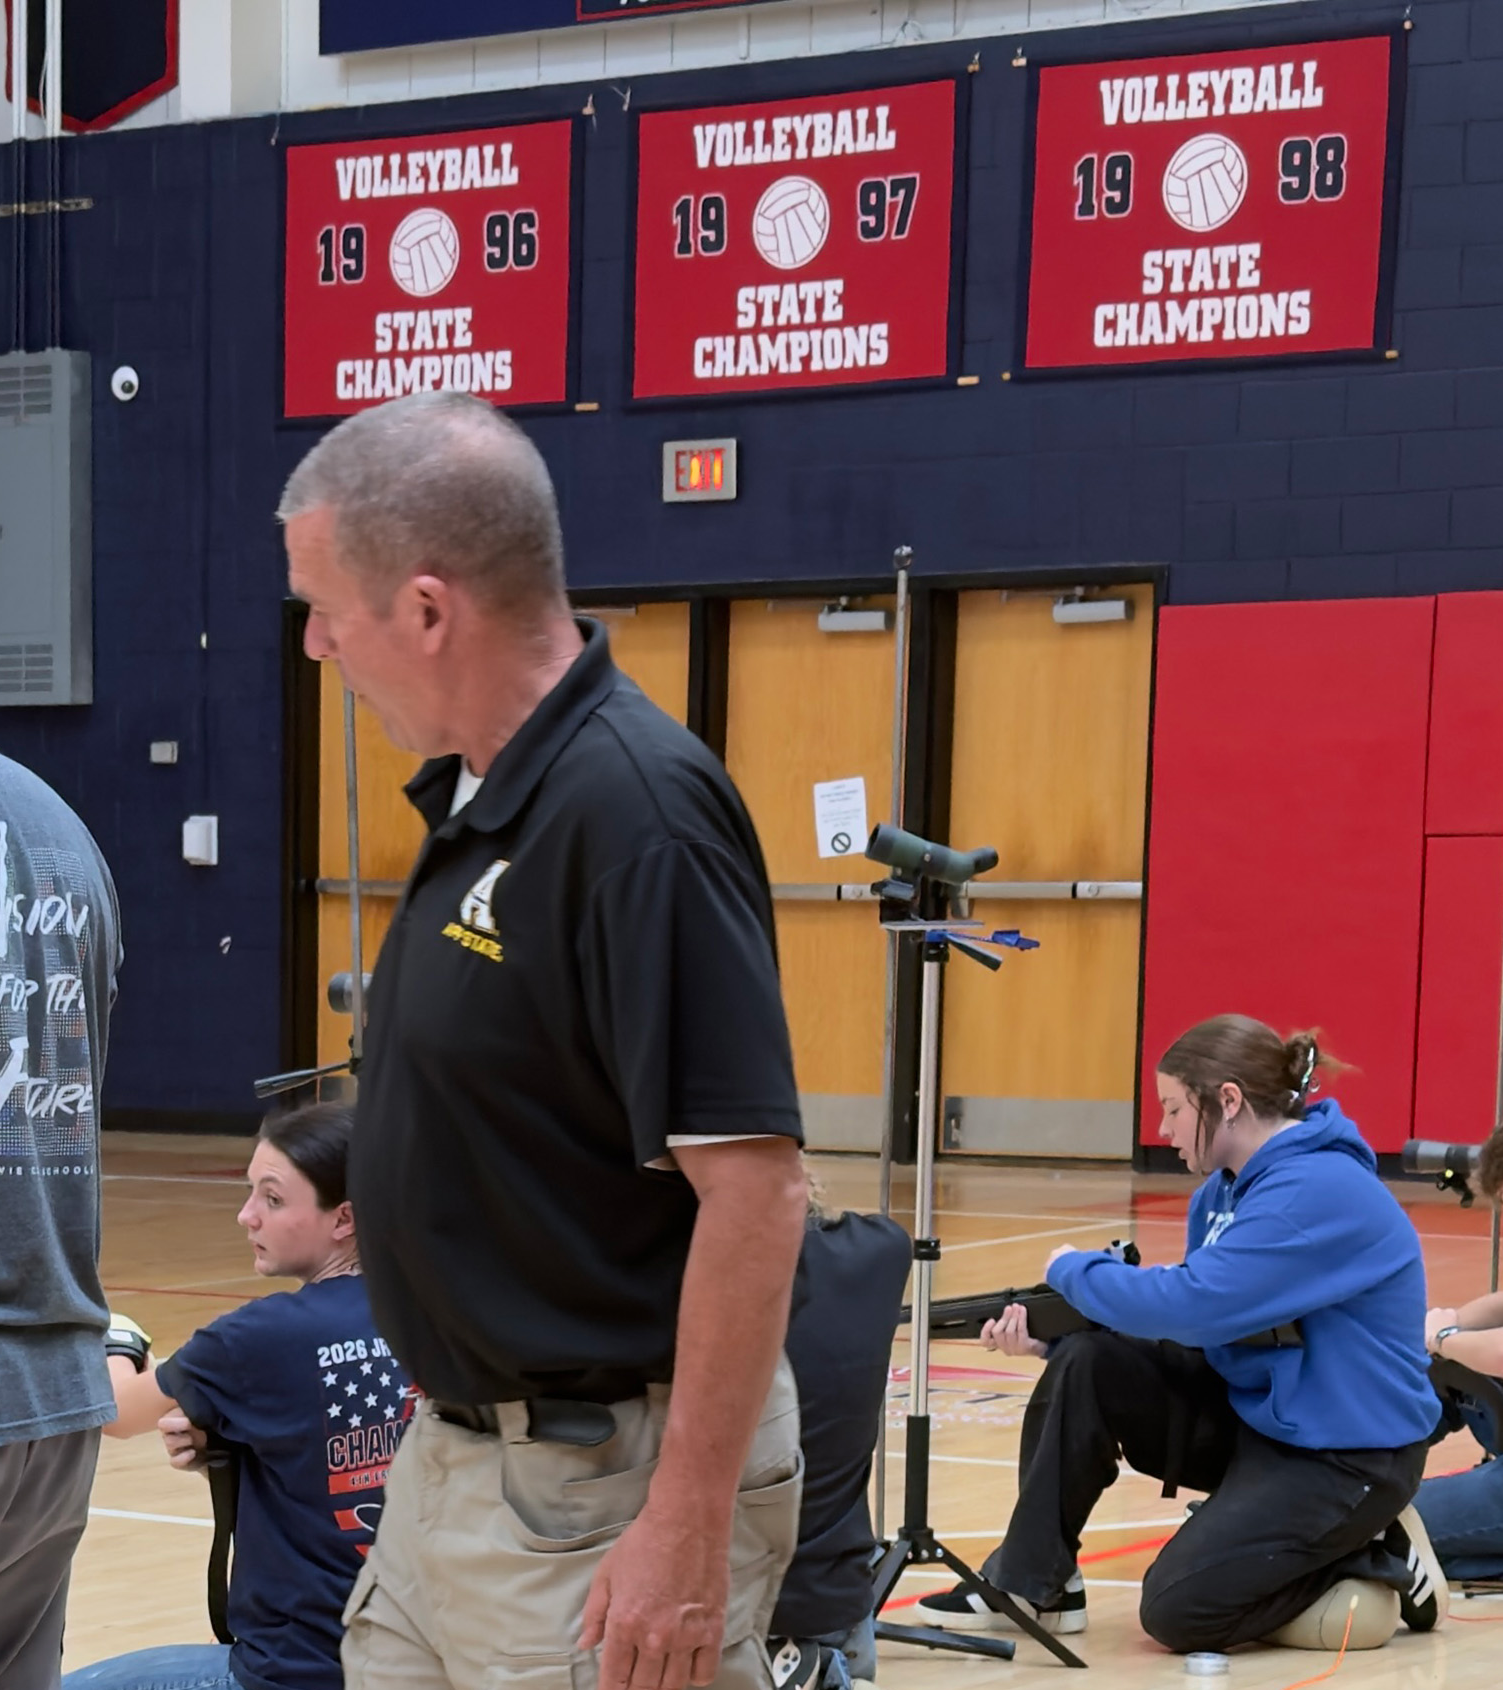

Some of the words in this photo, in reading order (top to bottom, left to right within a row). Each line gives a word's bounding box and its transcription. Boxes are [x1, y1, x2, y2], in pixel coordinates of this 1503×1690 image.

[1100, 60, 1324, 125] VOLLEYBALL
[693, 105, 896, 168] VOLLEYBALL
[335, 143, 519, 200] VOLLEYBALL
[1074, 151, 1134, 220] 19
[1278, 133, 1347, 205] 98
[672, 193, 727, 258] 19
[856, 173, 920, 242] 97
[316, 223, 366, 285] 19
[483, 208, 539, 273] 96
[1142, 243, 1261, 295] STATE
[375, 307, 473, 353] STATE
[736, 279, 844, 329] STATE
[1094, 290, 1312, 348] CHAMPIONS
[336, 350, 512, 400] CHAMPIONS
[694, 323, 889, 378] CHAMPIONS
[675, 447, 726, 492] EXIT
[317, 1338, 368, 1368] 2026
